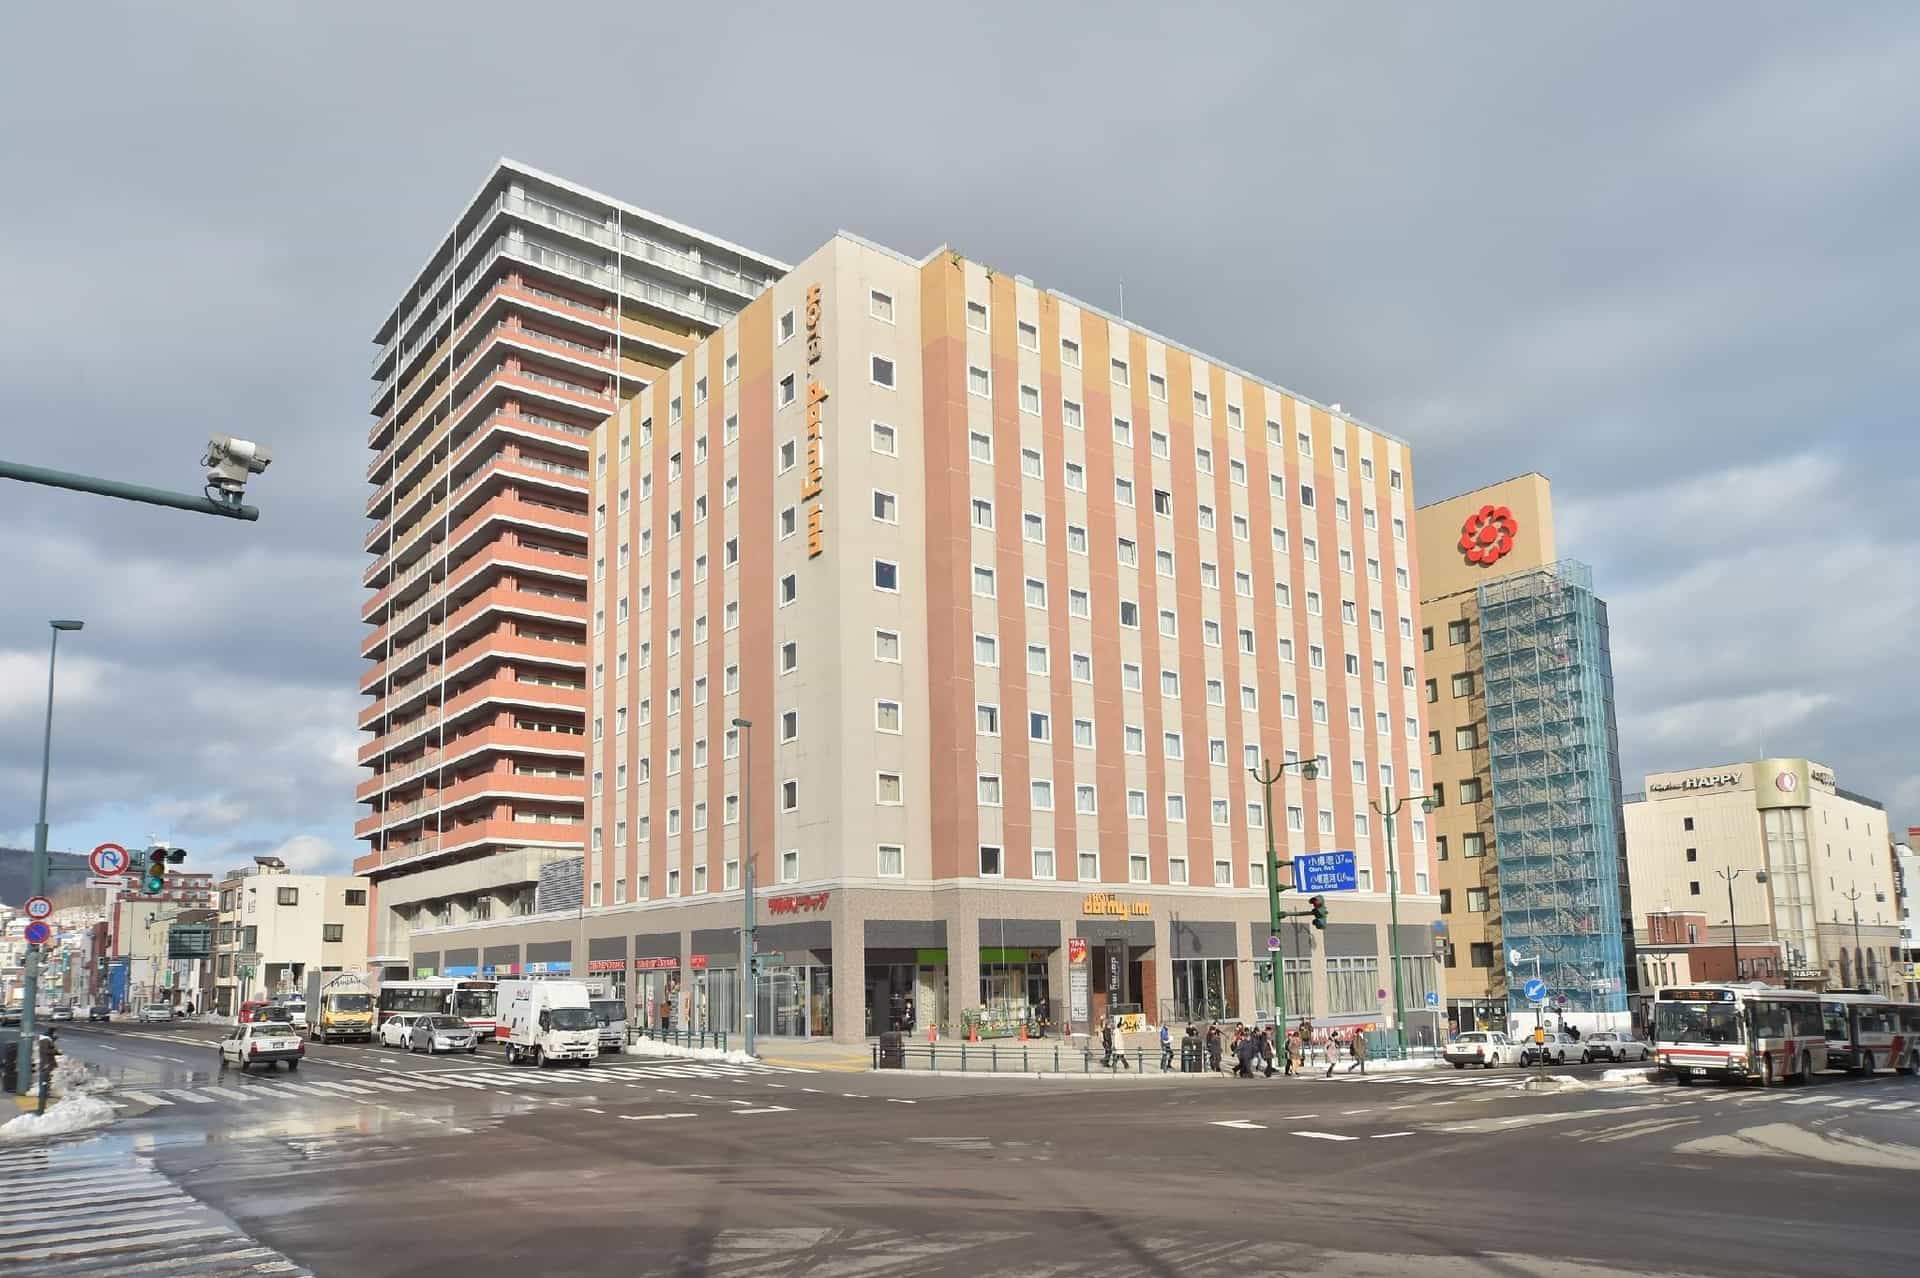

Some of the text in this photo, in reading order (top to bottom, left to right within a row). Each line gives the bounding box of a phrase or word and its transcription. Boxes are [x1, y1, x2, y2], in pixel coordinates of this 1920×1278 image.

[1686, 772, 1742, 789] HAPPY
[31, 903, 47, 914] 40
[1083, 900, 1151, 920] dormy inn
